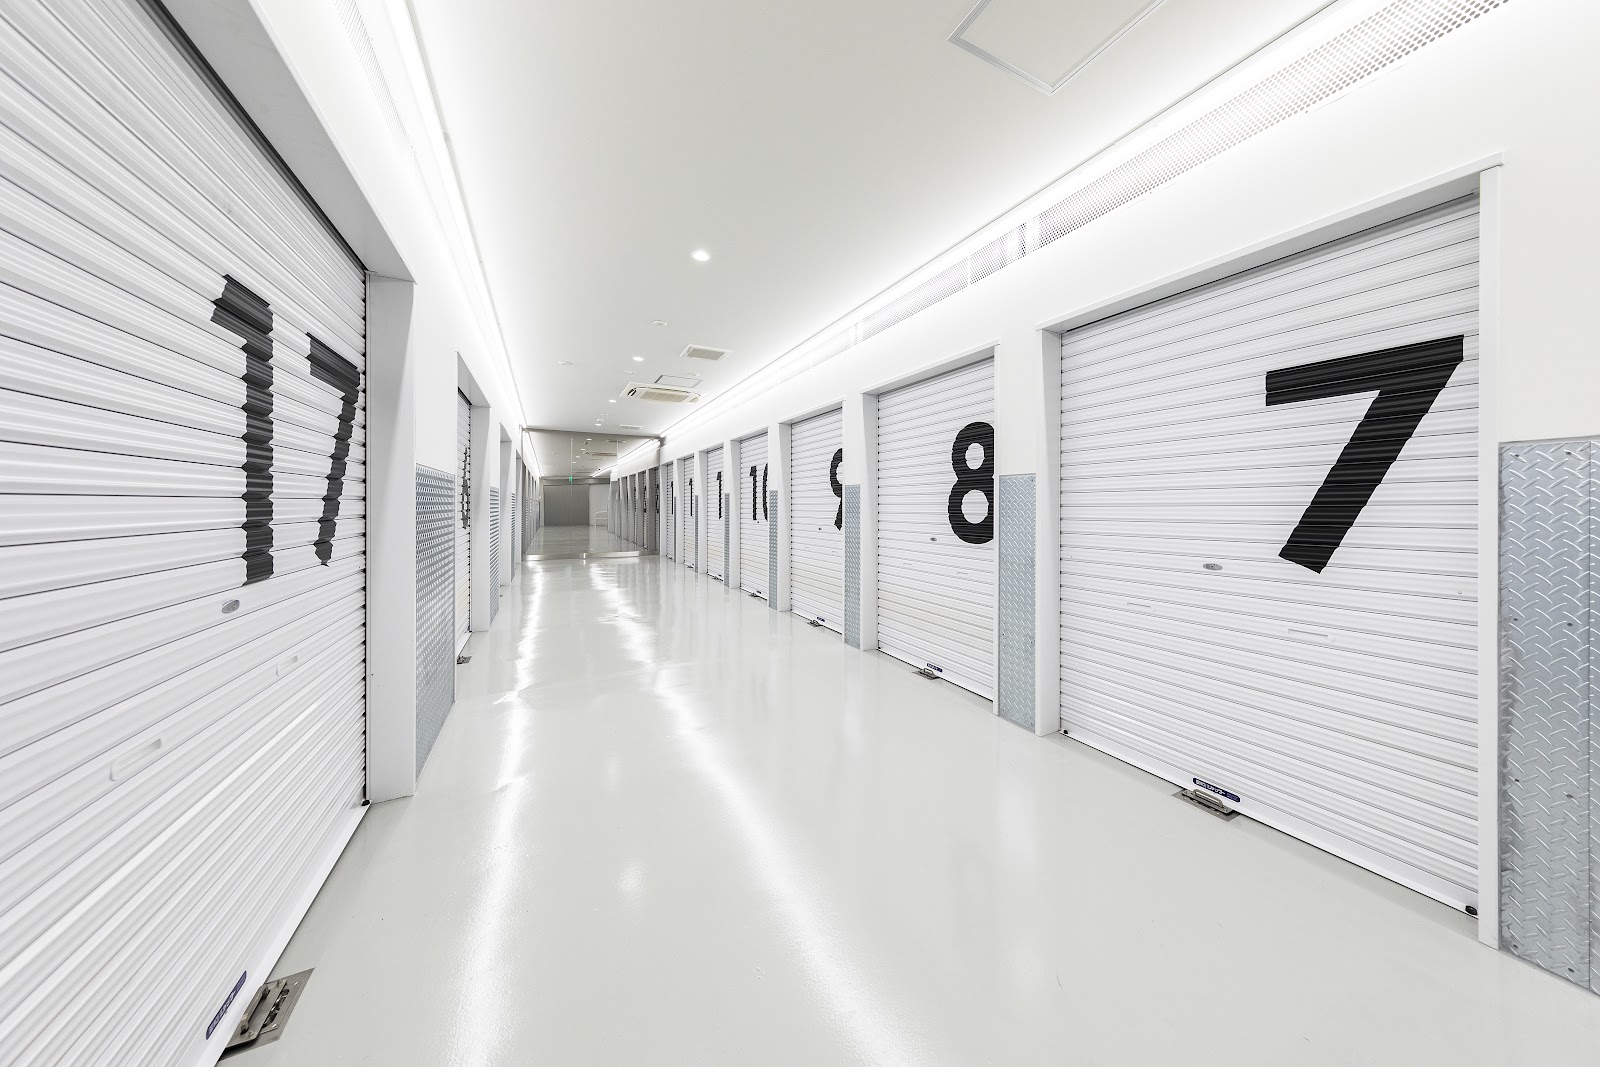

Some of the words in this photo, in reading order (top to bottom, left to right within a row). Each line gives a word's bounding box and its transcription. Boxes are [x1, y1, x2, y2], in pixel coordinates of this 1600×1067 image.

[210, 273, 360, 586] 17
[947, 421, 995, 545] 8
[1265, 333, 1465, 575] 7
